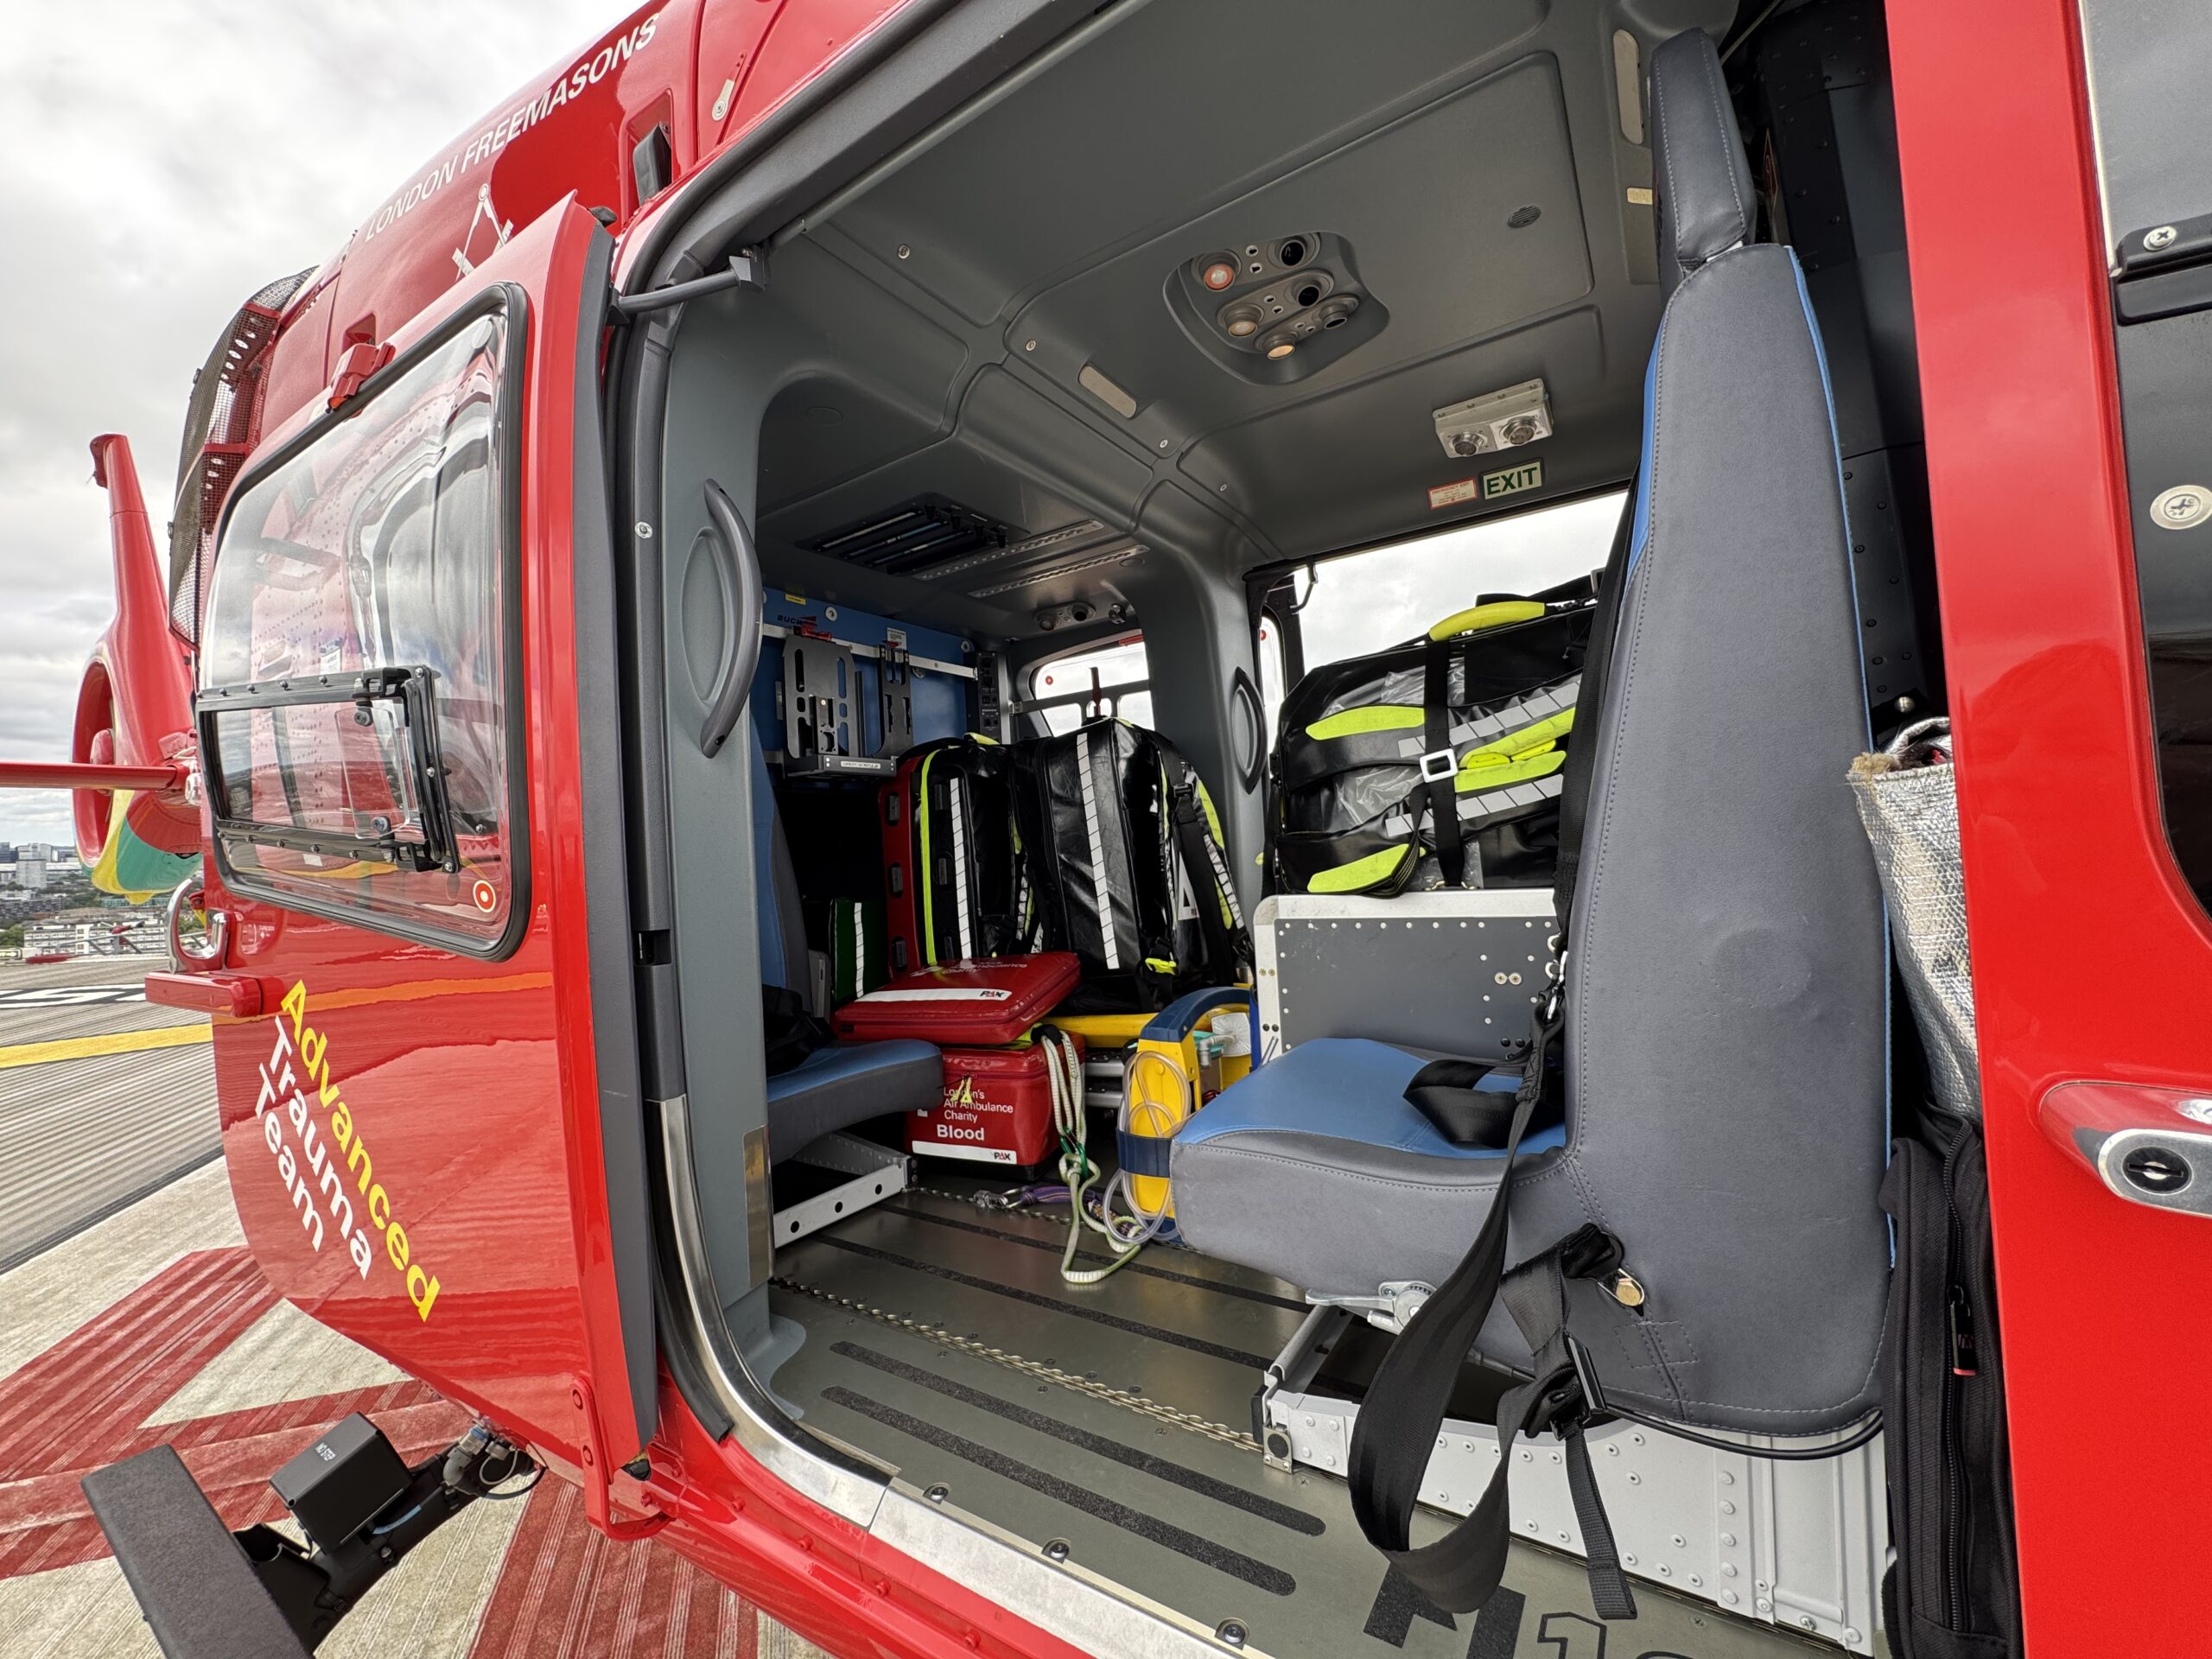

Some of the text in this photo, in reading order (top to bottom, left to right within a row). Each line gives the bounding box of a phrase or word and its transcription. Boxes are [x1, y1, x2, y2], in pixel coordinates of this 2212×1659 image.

[365, 13, 659, 243] LONDON FREEMASONS
[1486, 467, 1537, 496] EXIT
[777, 614, 817, 626] BUCH
[944, 1086, 985, 1100] Lon's
[944, 1098, 1014, 1114] Air Ambulance
[944, 1109, 978, 1124] Charity
[937, 1124, 985, 1141] Blood
[270, 1015, 372, 1281] Trauma
[281, 980, 441, 1323] Advanced
[994, 1152, 1011, 1161] PAX
[255, 1062, 327, 1252] Team
